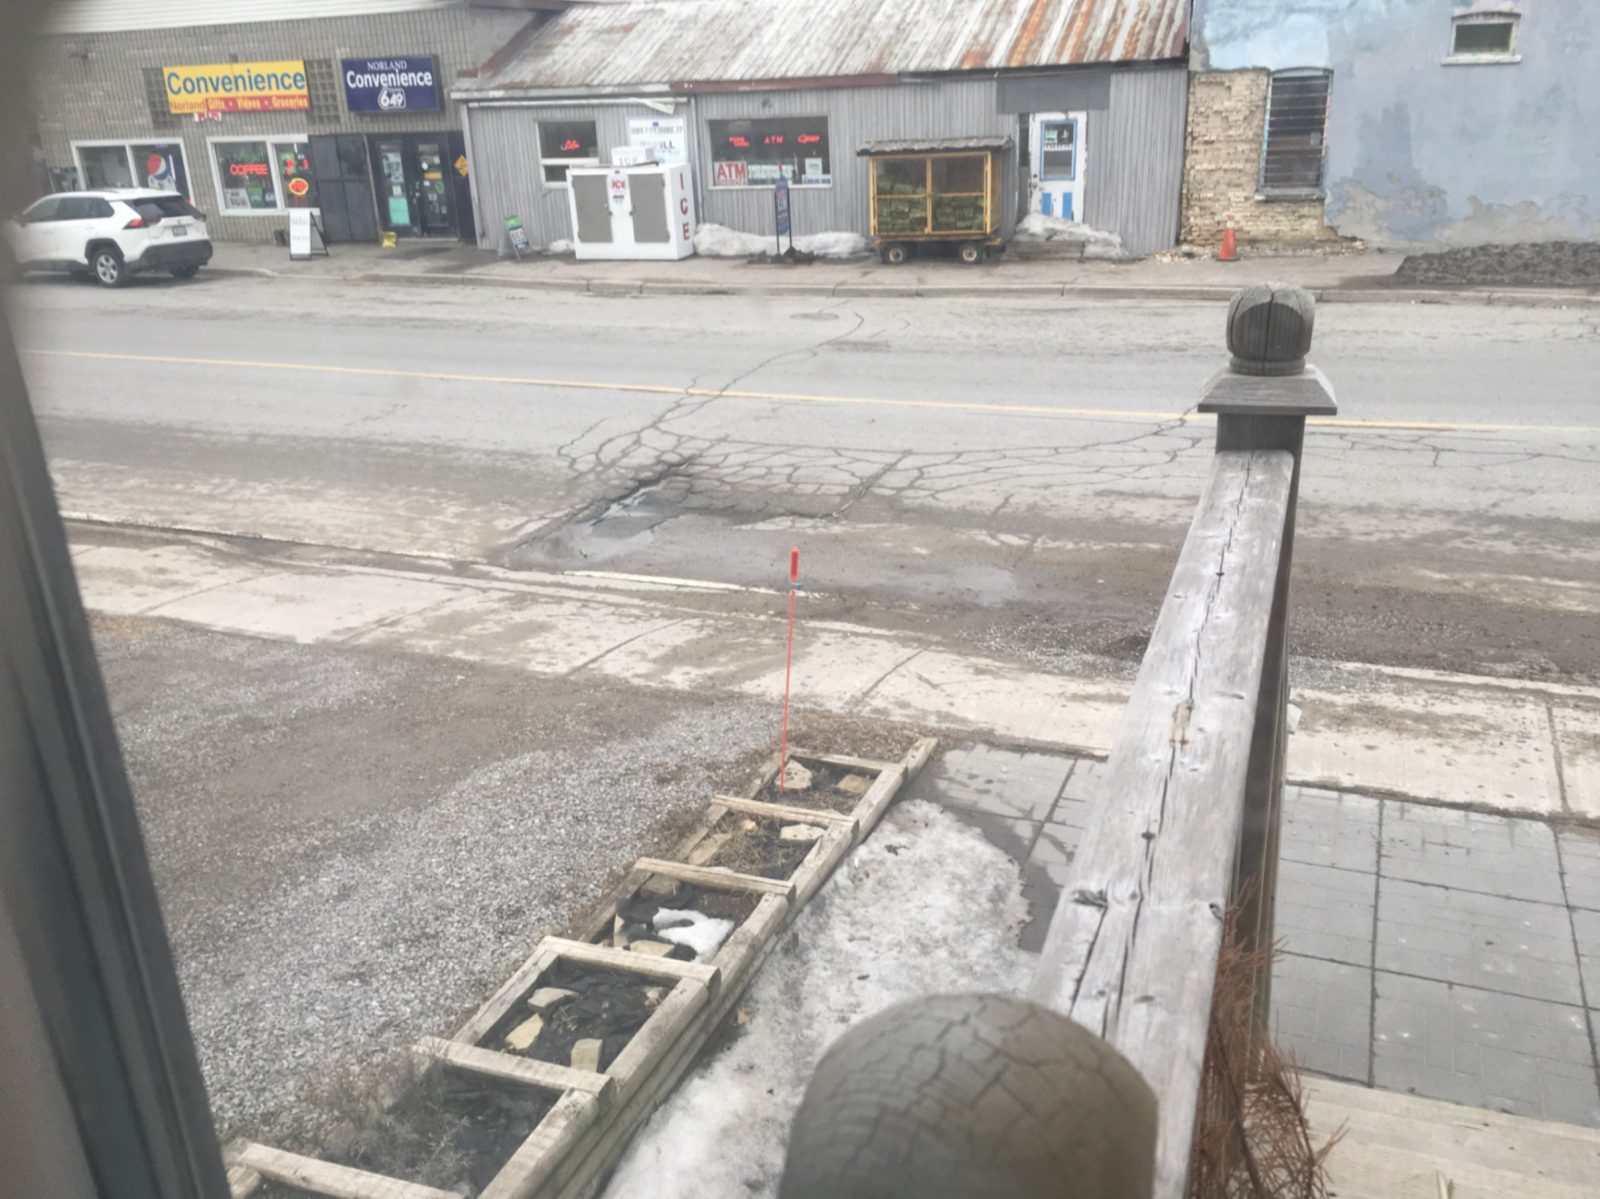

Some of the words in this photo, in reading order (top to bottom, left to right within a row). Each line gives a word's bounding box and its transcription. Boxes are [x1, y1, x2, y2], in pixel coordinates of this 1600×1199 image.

[367, 60, 407, 71] NORLAND
[167, 69, 306, 95] Convenience
[346, 68, 433, 89] Convenience
[170, 100, 205, 111] Norland
[764, 134, 784, 144] ATM
[230, 164, 269, 175] COFFEE
[717, 163, 746, 179] ATM
[612, 179, 626, 189] ICE
[680, 172, 690, 240] ICE
